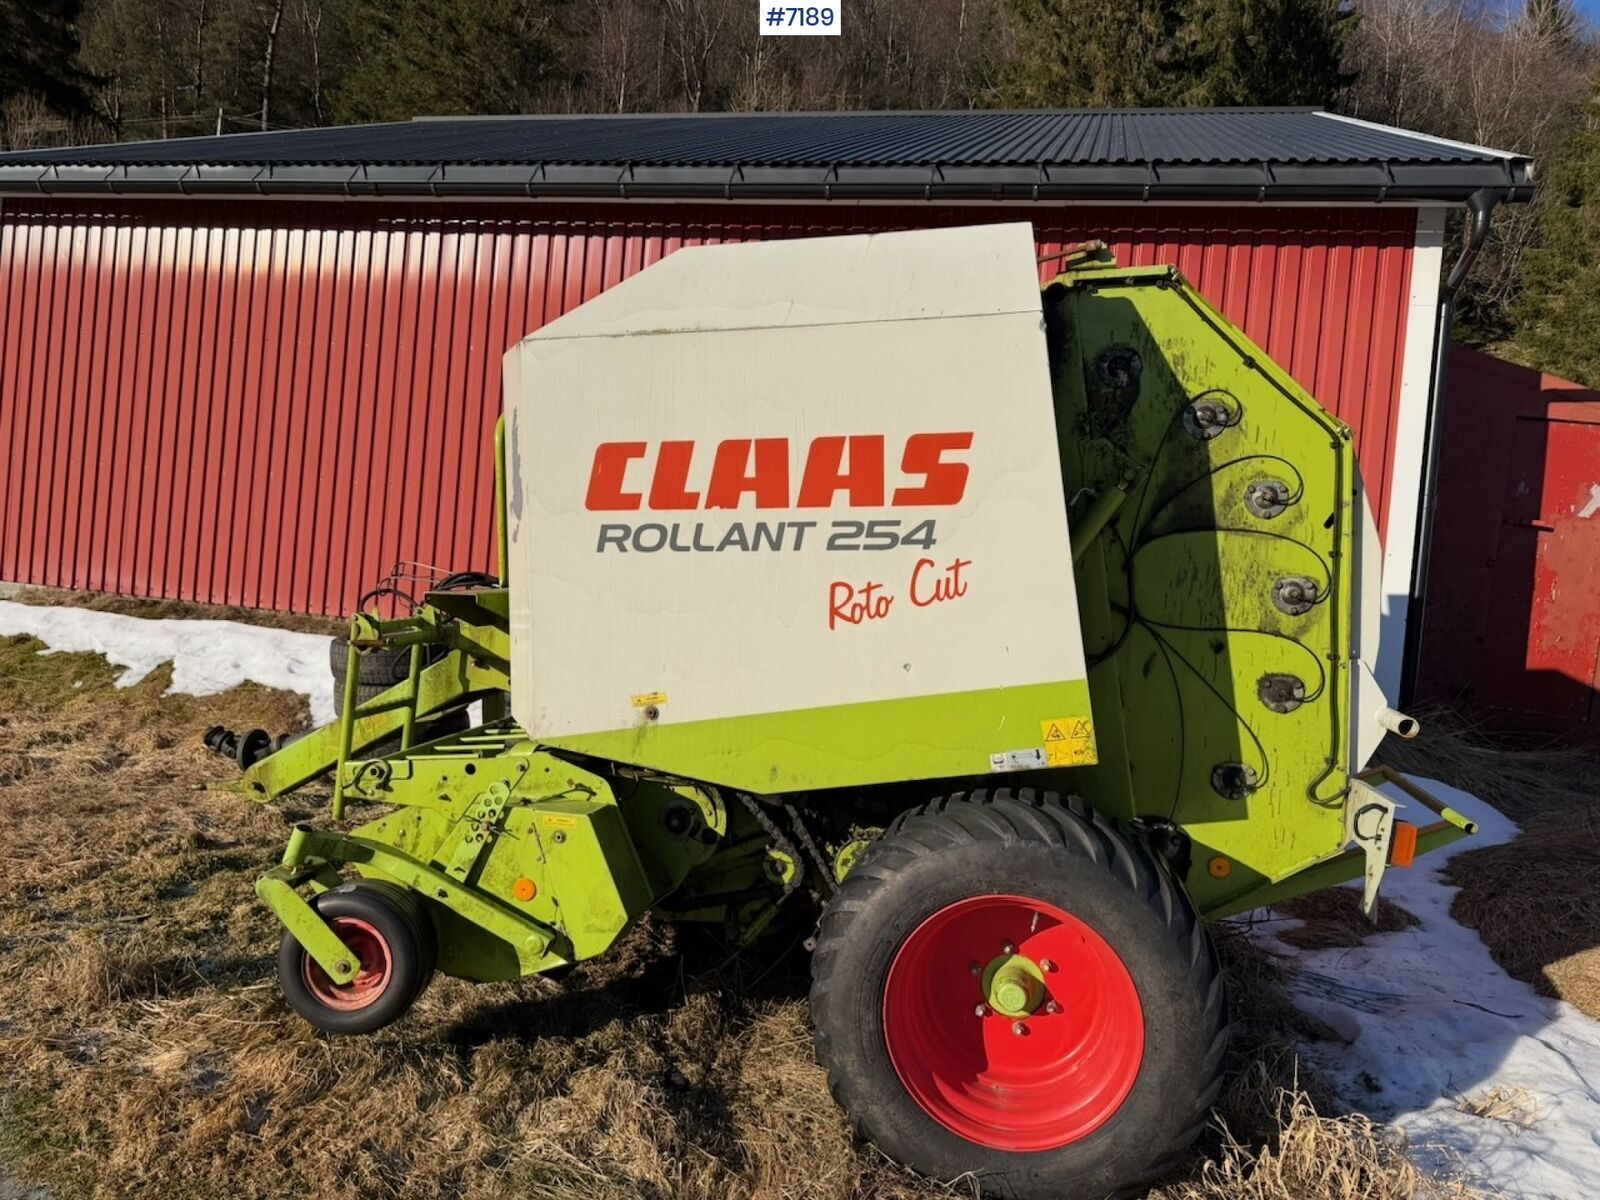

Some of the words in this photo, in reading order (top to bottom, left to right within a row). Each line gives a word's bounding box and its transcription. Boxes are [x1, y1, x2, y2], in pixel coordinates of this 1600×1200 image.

[585, 432, 974, 511] CLAAS
[596, 522, 817, 552] ROLLANT
[826, 519, 937, 551] 254
[828, 581, 894, 630] Roto
[909, 558, 972, 607] Cut
